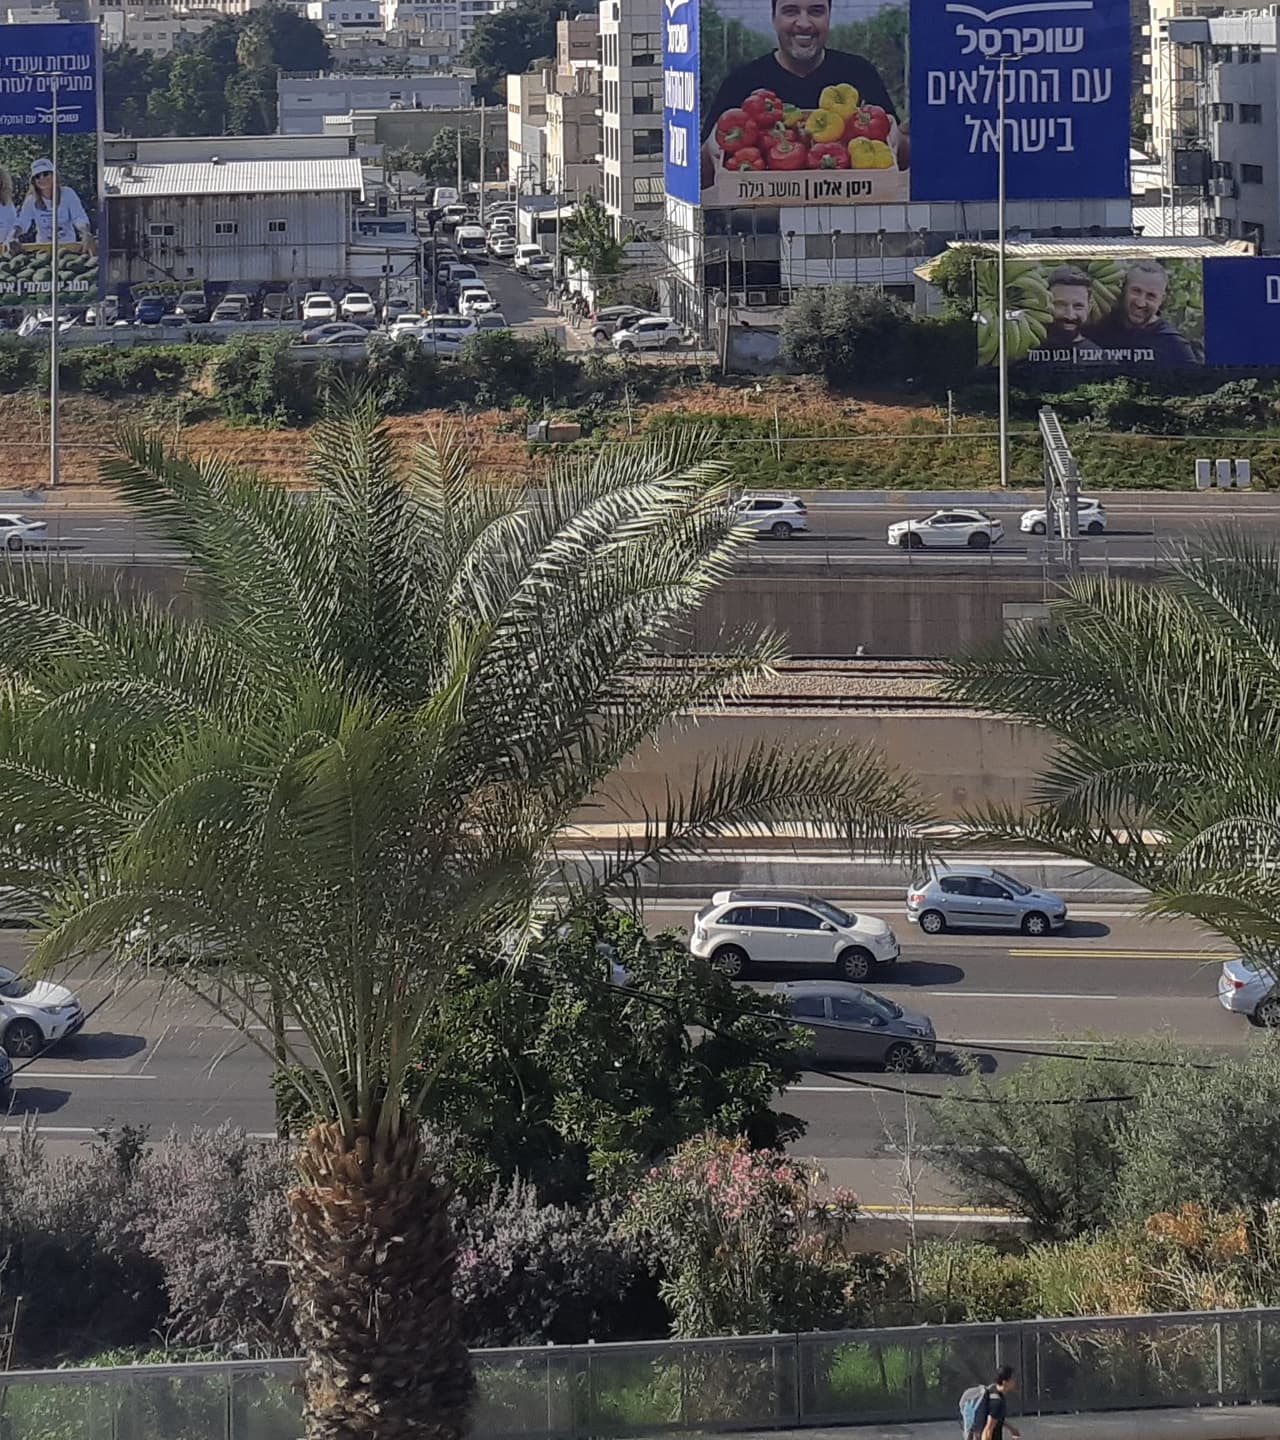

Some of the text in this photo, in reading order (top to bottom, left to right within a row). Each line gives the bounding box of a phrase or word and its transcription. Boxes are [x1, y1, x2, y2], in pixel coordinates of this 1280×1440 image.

[956, 24, 1084, 55] שופרסל
[5, 56, 42, 72] ועובדי
[46, 55, 90, 71] עובדות
[37, 76, 92, 92] מתגייסים
[928, 65, 1112, 110] עם החקלאים
[38, 113, 79, 124] שופסל
[965, 115, 1074, 153] בישראל
[738, 180, 872, 199] ניסן אלון מושב גילת
[1027, 348, 1050, 361] כרמל
[1080, 348, 1102, 361] אבני
[1104, 348, 1131, 361] ויאיר
[1133, 348, 1154, 362] ברק
